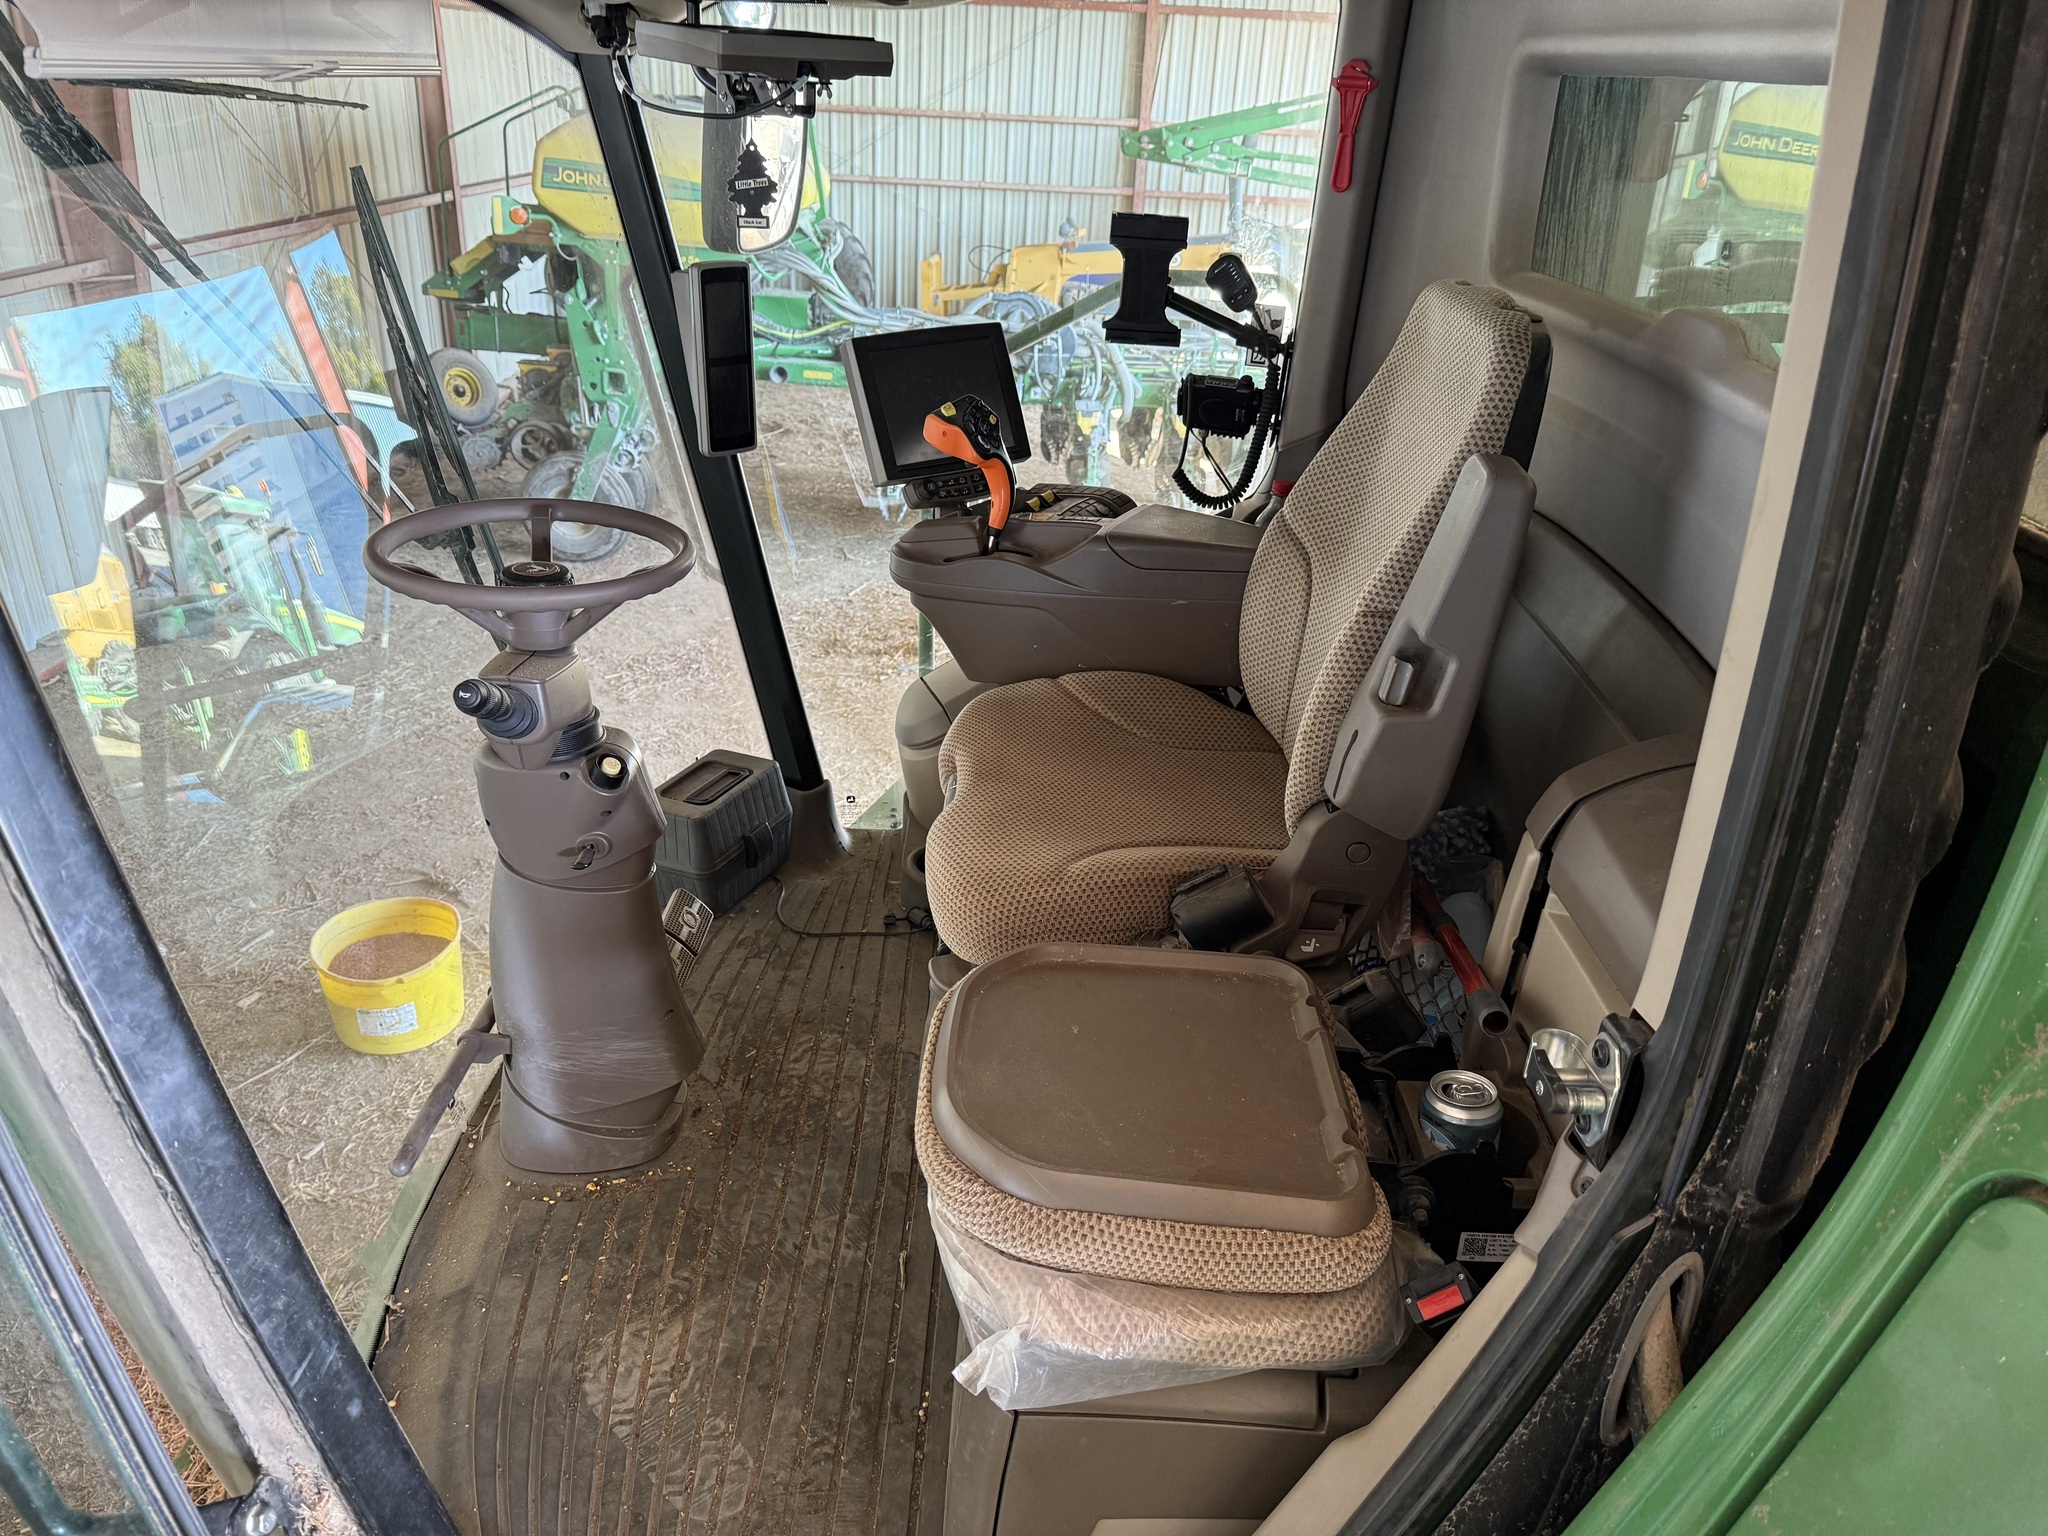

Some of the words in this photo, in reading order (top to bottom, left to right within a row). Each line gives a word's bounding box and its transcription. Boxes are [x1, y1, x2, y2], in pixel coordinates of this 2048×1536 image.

[1732, 131, 1776, 150] JOHN
[552, 166, 600, 186] JOHN
[737, 181, 752, 189] Little
[753, 179, 767, 187] Trees
